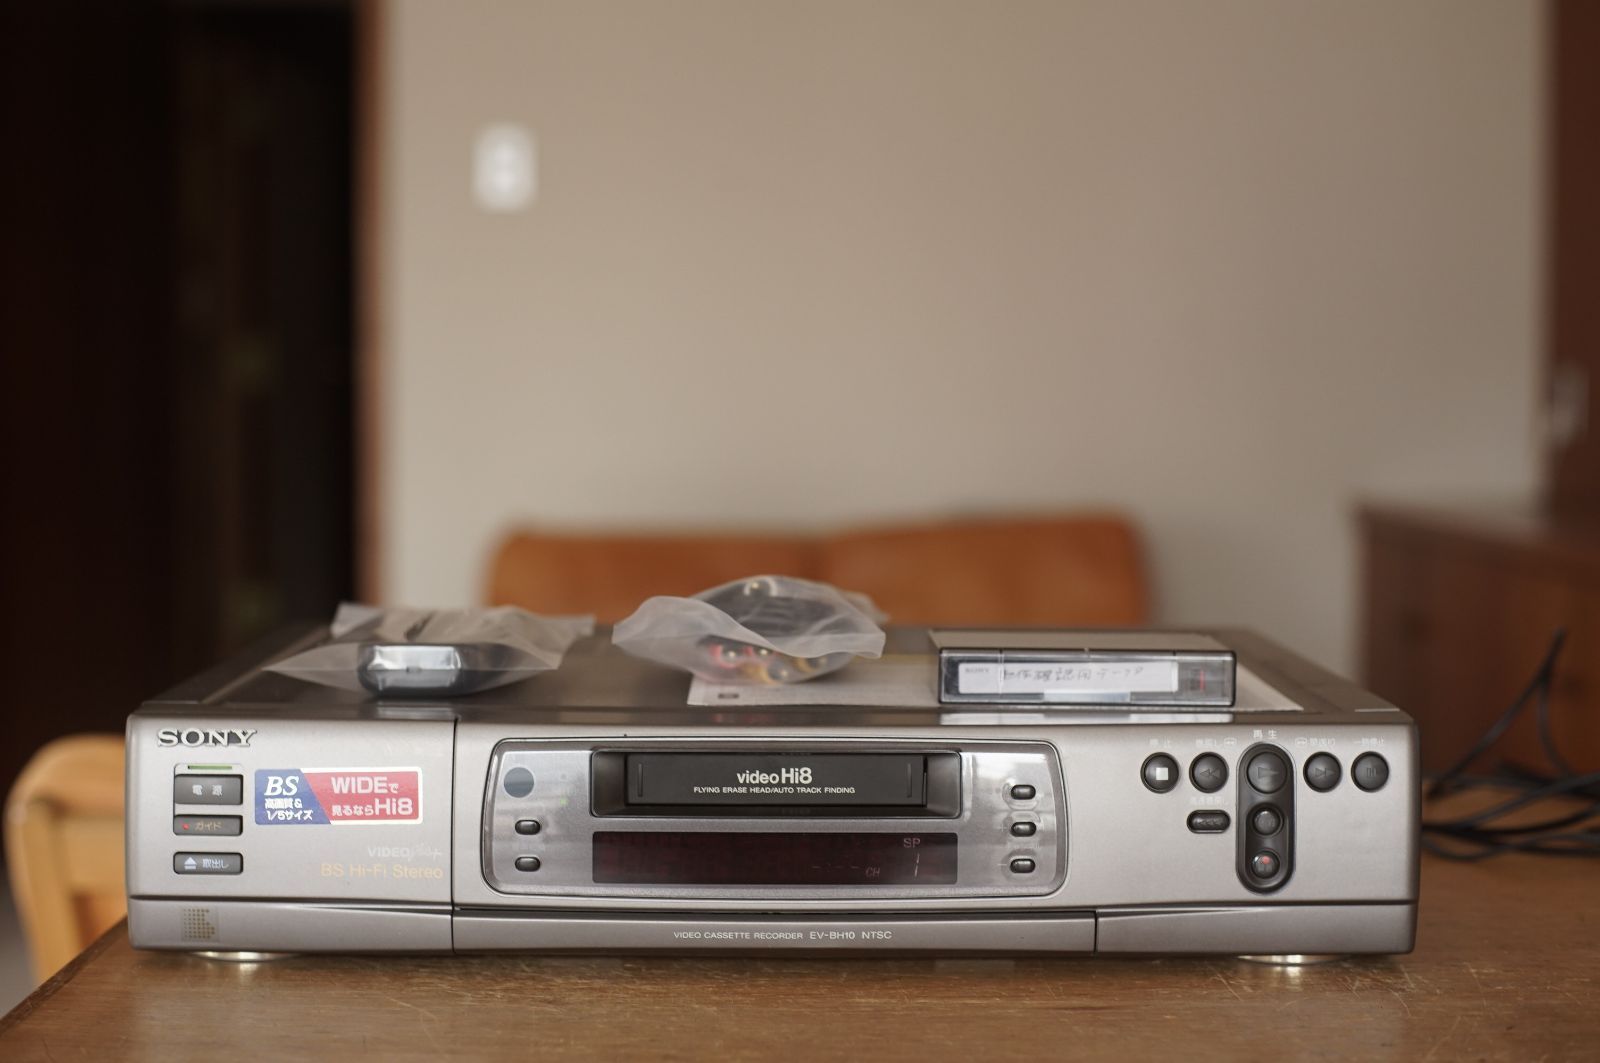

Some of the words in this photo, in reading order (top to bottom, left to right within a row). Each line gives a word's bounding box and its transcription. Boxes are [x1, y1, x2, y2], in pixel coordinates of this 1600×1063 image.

[157, 727, 258, 747] SONY
[736, 770, 780, 784] video
[781, 767, 813, 785] Hi8
[264, 776, 300, 796] BS
[331, 776, 400, 794] WIDEで
[693, 786, 721, 794] FLYING
[722, 786, 748, 794] ERASE
[750, 786, 794, 794] HEAD/AUTO
[797, 786, 822, 794] TRACK
[824, 786, 856, 794] FINDING
[332, 797, 414, 817] 見るならHi8
[195, 821, 222, 831] ガイド
[903, 837, 921, 849] SP
[202, 858, 229, 869] 取出し
[320, 863, 345, 878] BS
[349, 863, 387, 878] Hi-Fi
[392, 864, 444, 879] Stereo
[673, 931, 702, 939] VIDEO
[704, 931, 750, 940] CASSETTE
[754, 932, 803, 940] RECORDER
[809, 931, 856, 940] EV-BH10
[861, 931, 892, 940] NTSC
